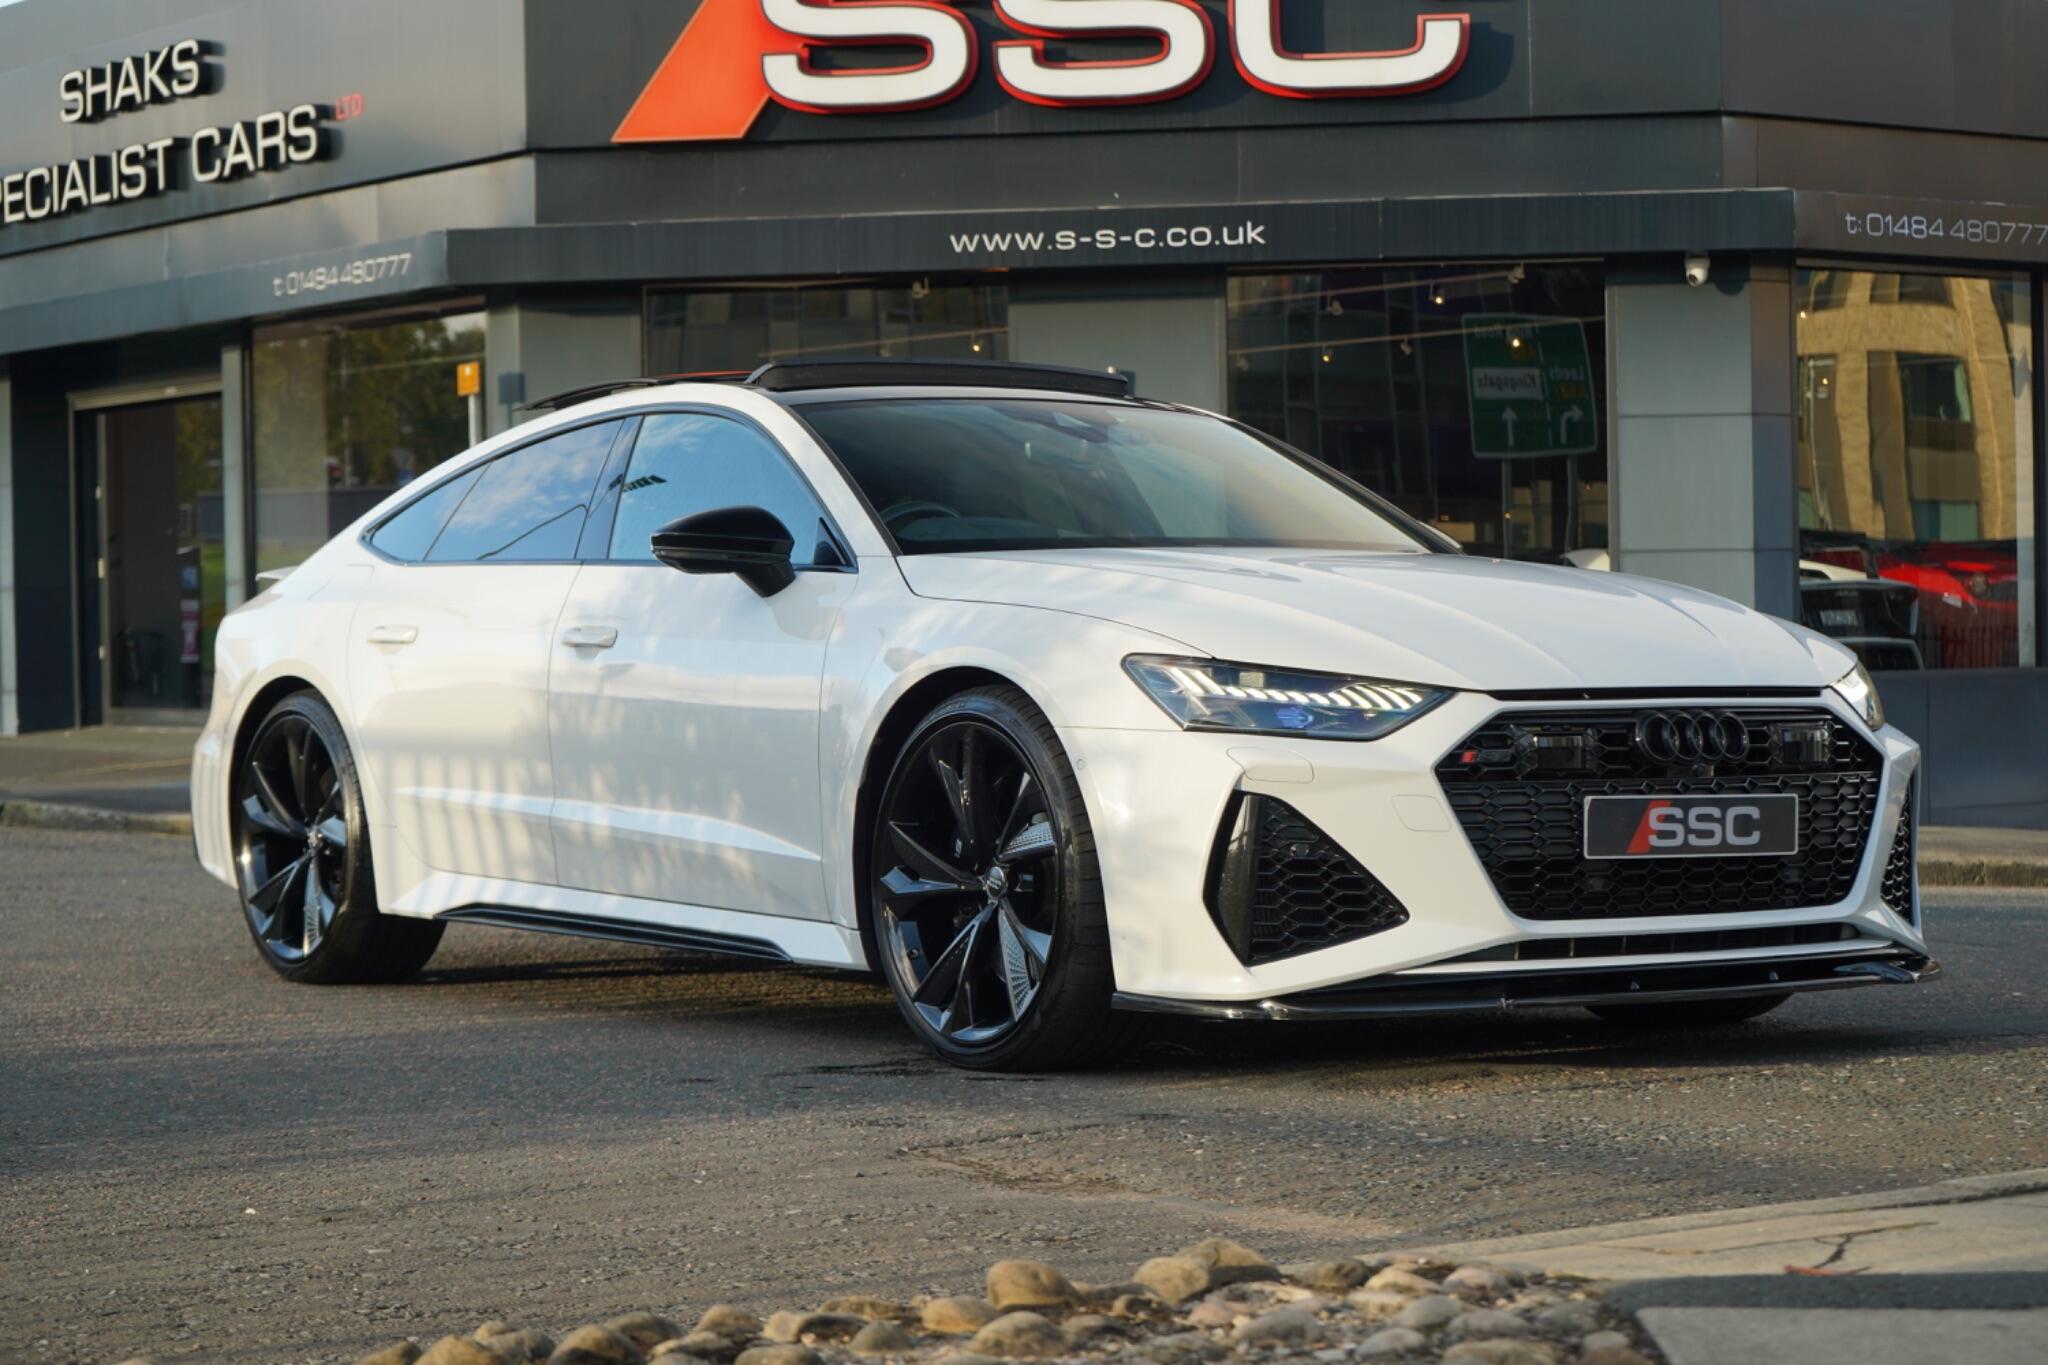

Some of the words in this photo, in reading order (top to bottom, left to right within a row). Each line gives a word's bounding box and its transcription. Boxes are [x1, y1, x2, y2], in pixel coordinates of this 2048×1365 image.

[60, 39, 199, 123] SHAKS
[0, 137, 174, 223] ECIALIST
[192, 104, 317, 182] CARS
[334, 93, 364, 121] LTD
[949, 220, 1266, 253] www.s-s-c.co.uk
[1648, 806, 1761, 848] SSC
